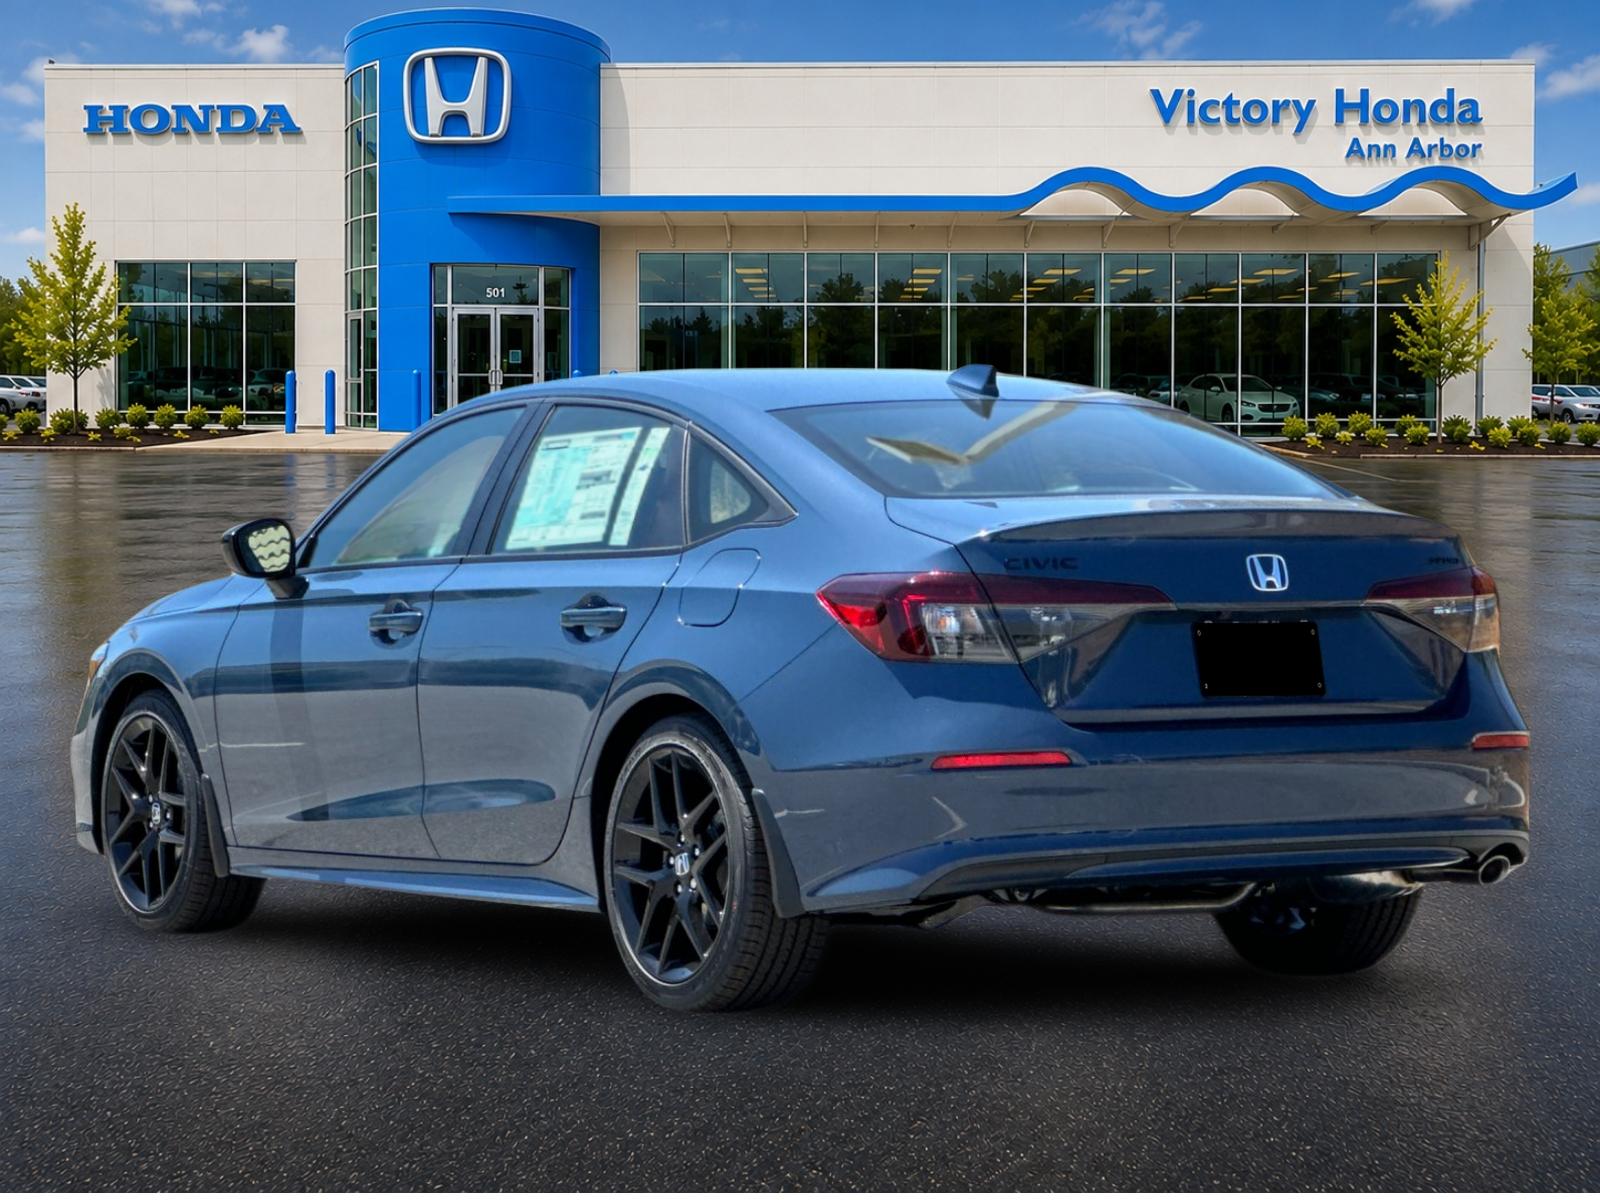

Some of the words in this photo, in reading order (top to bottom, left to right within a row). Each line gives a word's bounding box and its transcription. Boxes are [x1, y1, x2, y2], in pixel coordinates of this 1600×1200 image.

[82, 104, 301, 136] HONDA
[1149, 88, 1316, 136] Victory
[1334, 88, 1483, 126] Honda
[1345, 137, 1397, 159] Ann
[1405, 137, 1482, 159] Arbor
[485, 287, 505, 298] 501
[1003, 557, 1079, 571] CIVIC
